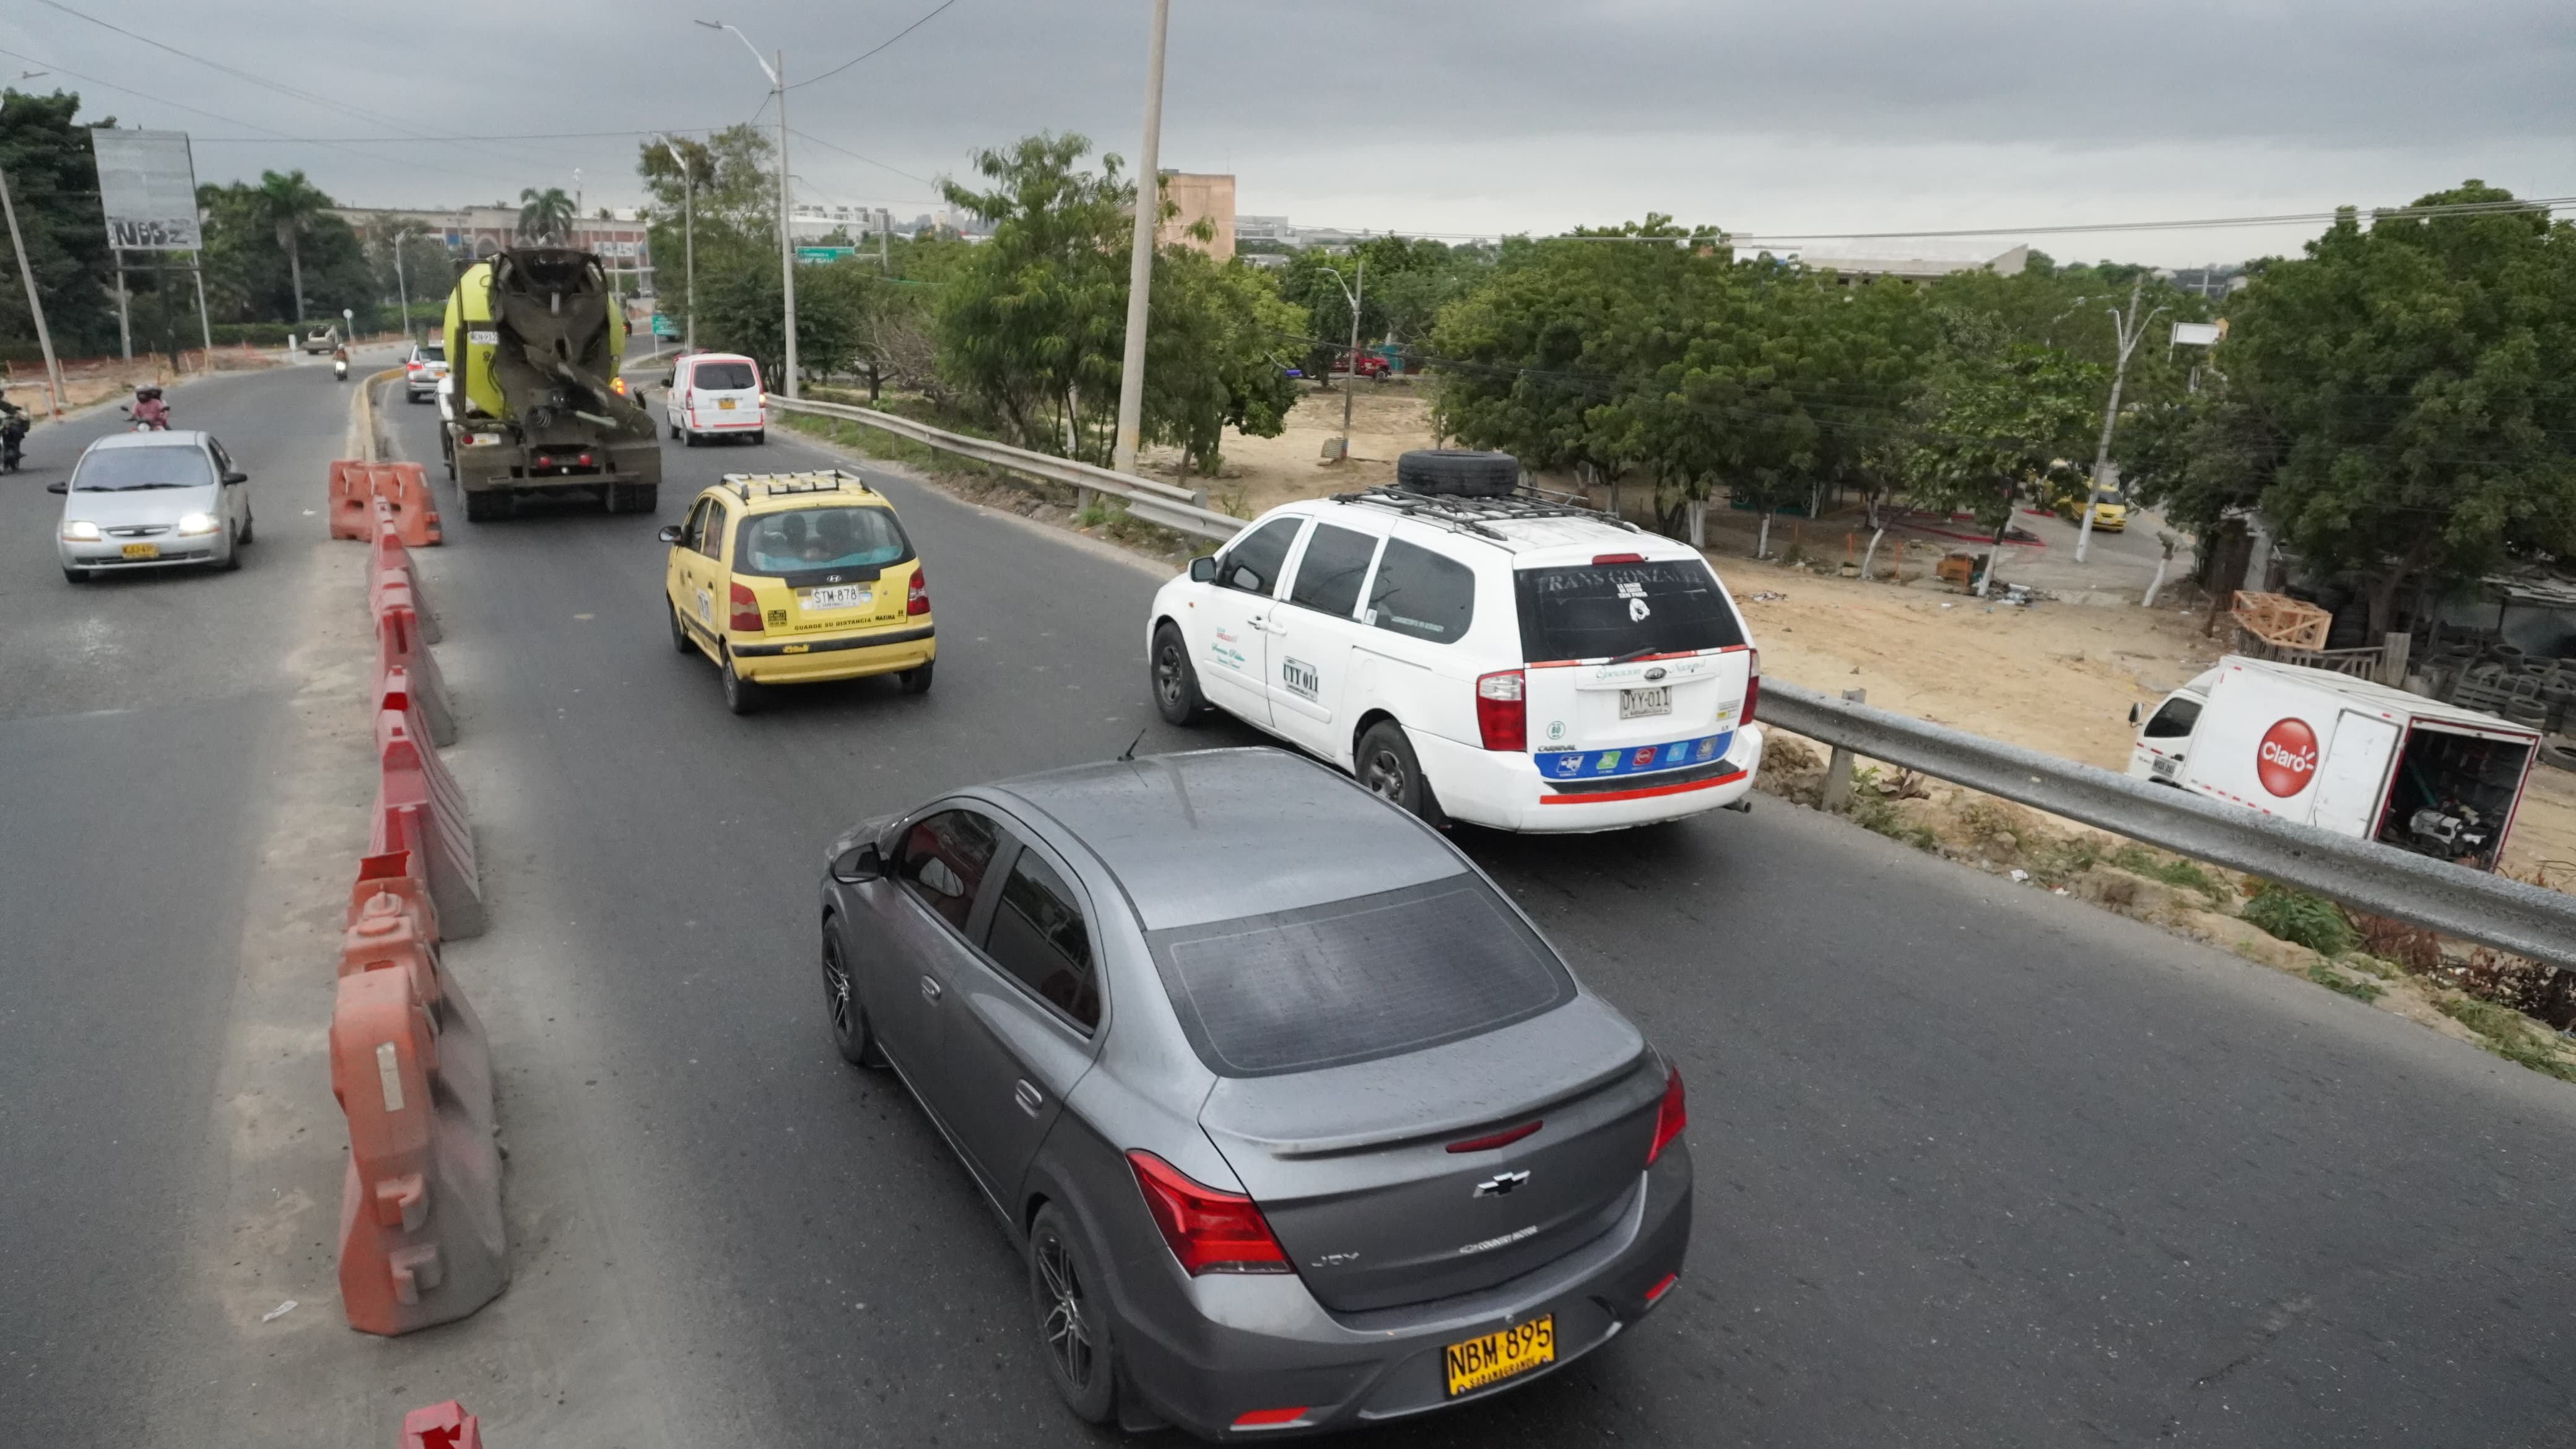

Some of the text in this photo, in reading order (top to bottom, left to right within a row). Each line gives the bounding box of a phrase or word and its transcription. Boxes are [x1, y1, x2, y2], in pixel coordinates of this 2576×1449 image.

[836, 617, 871, 627] DISTANCIA
[1284, 663, 1302, 685] UYY
[1303, 671, 1318, 694] 011
[2261, 741, 2306, 773] Claro
[1506, 1320, 1550, 1359] 895
